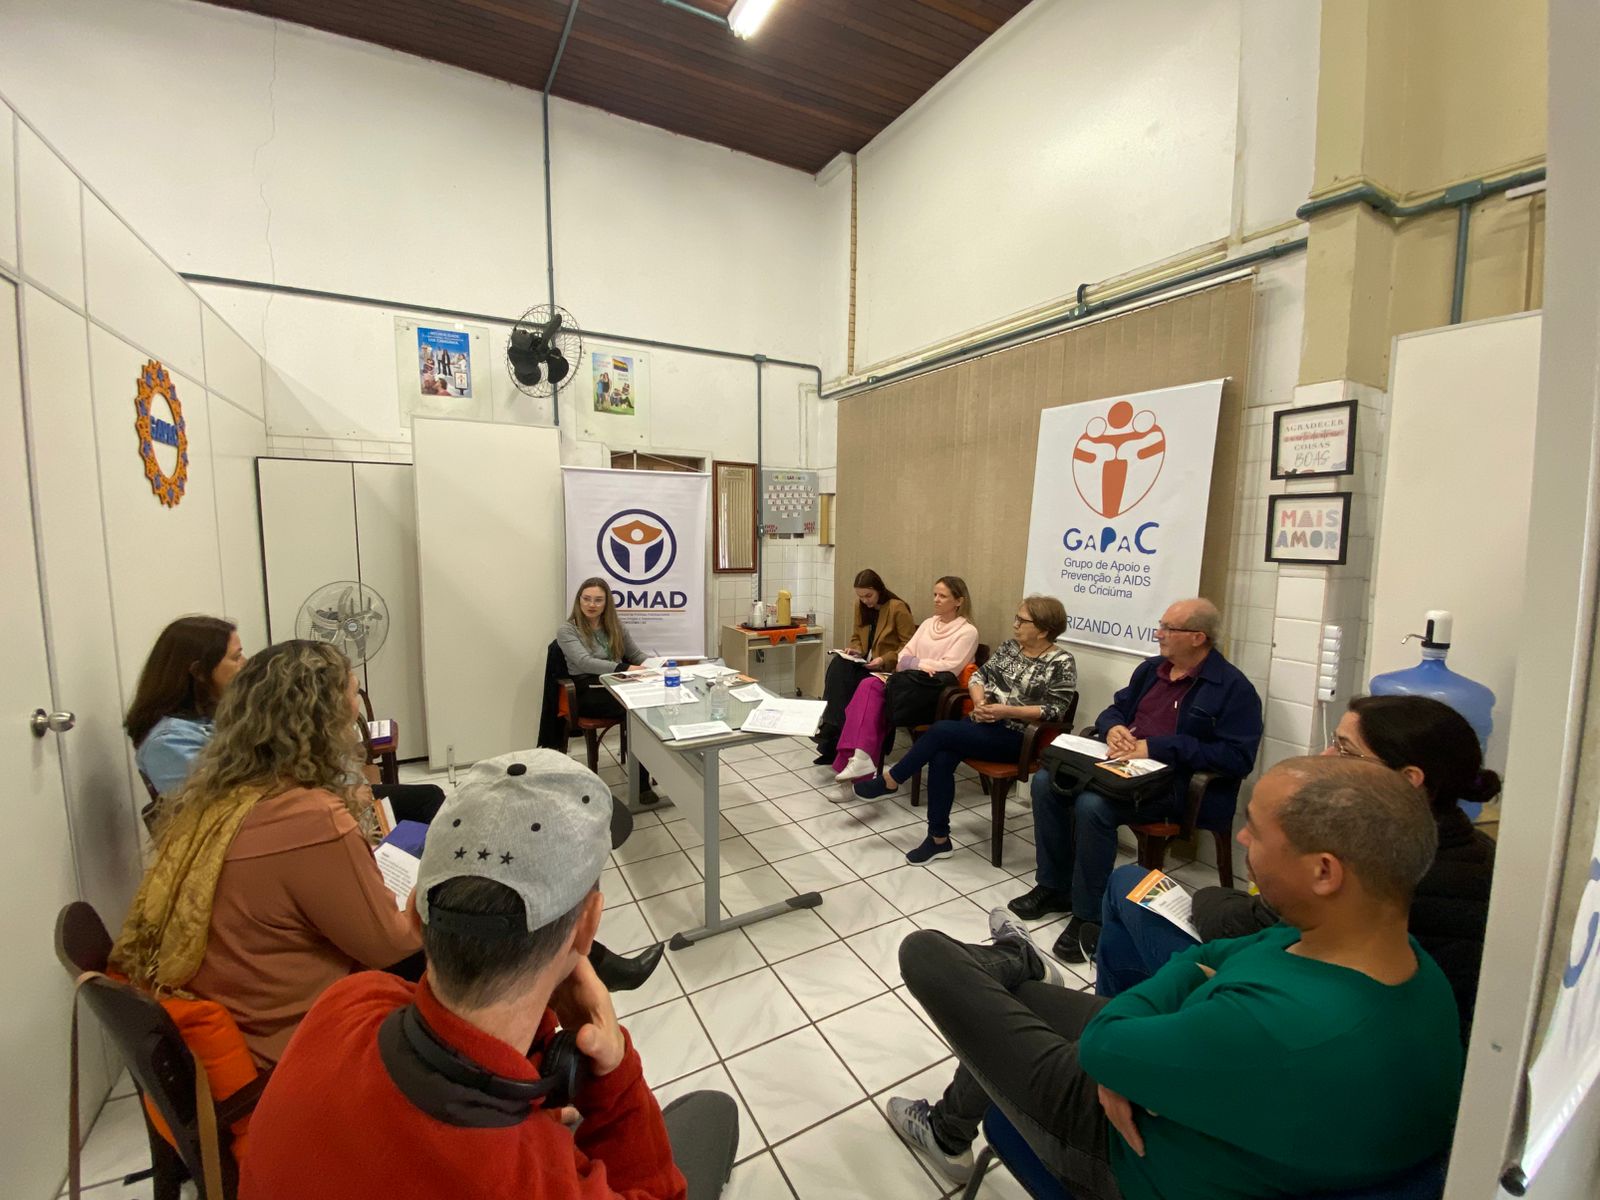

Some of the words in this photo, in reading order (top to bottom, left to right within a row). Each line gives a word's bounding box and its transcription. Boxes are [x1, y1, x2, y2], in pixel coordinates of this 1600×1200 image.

[1286, 419, 1344, 432] AGRADECER
[1294, 442, 1331, 451] COISAS
[1294, 450, 1331, 467] BOAS
[1280, 509, 1340, 528] MAIS
[1275, 530, 1338, 549] AMOR
[1063, 557, 1093, 570] Grupo
[1095, 560, 1108, 570] de
[1110, 560, 1141, 573] Apoio
[1143, 564, 1151, 573] e
[1061, 569, 1112, 585] Prevenção
[1122, 574, 1151, 587] AIDS
[1073, 583, 1086, 594] de
[1088, 584, 1133, 598] Criciúma
[611, 590, 688, 609] OMAD
[1066, 615, 1122, 637] RIZANDO
[1123, 624, 1134, 639] A
